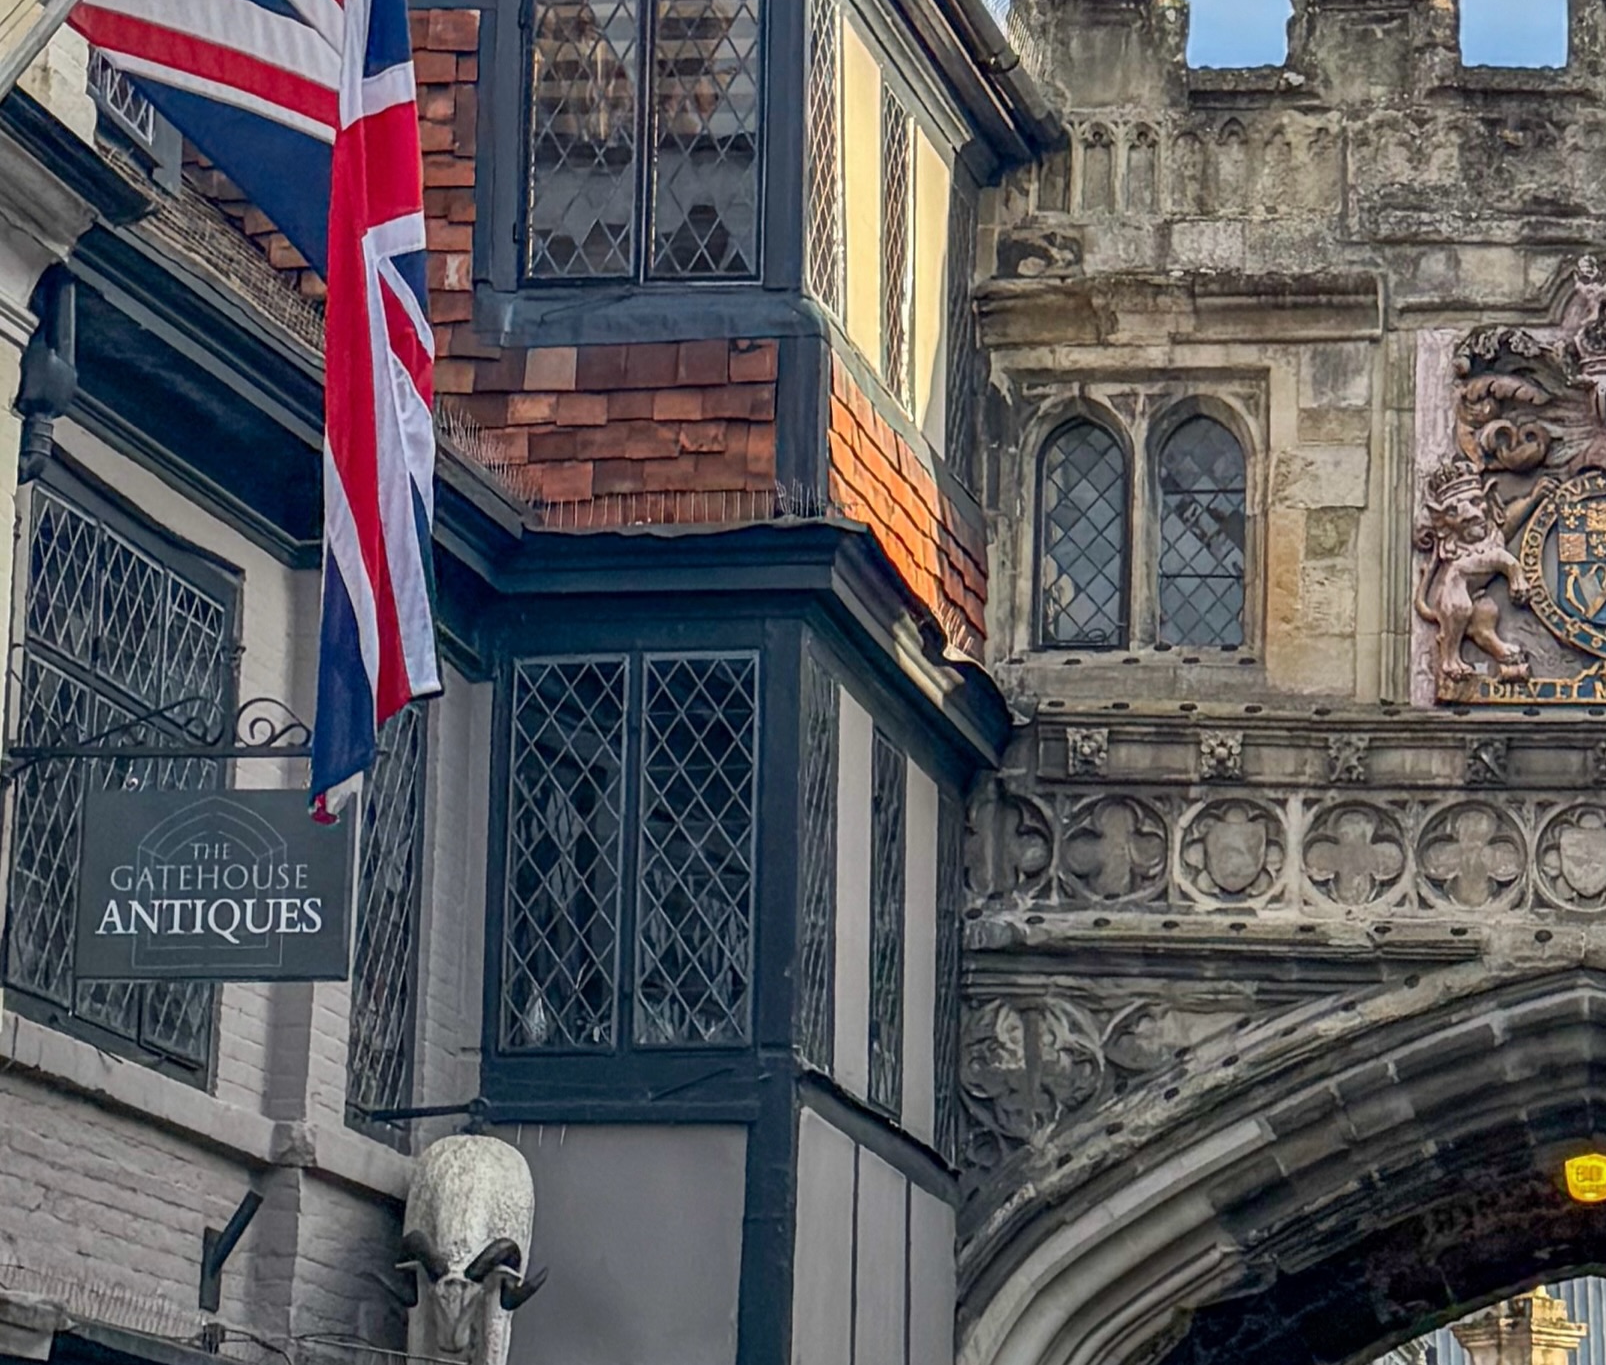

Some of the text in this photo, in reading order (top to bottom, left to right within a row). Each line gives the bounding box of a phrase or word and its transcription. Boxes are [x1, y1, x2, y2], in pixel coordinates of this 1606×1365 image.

[1556, 682, 1584, 699] ET
[190, 842, 231, 860] THE
[110, 863, 309, 892] GATEHOUSE
[95, 898, 323, 944] ANTIQUES
